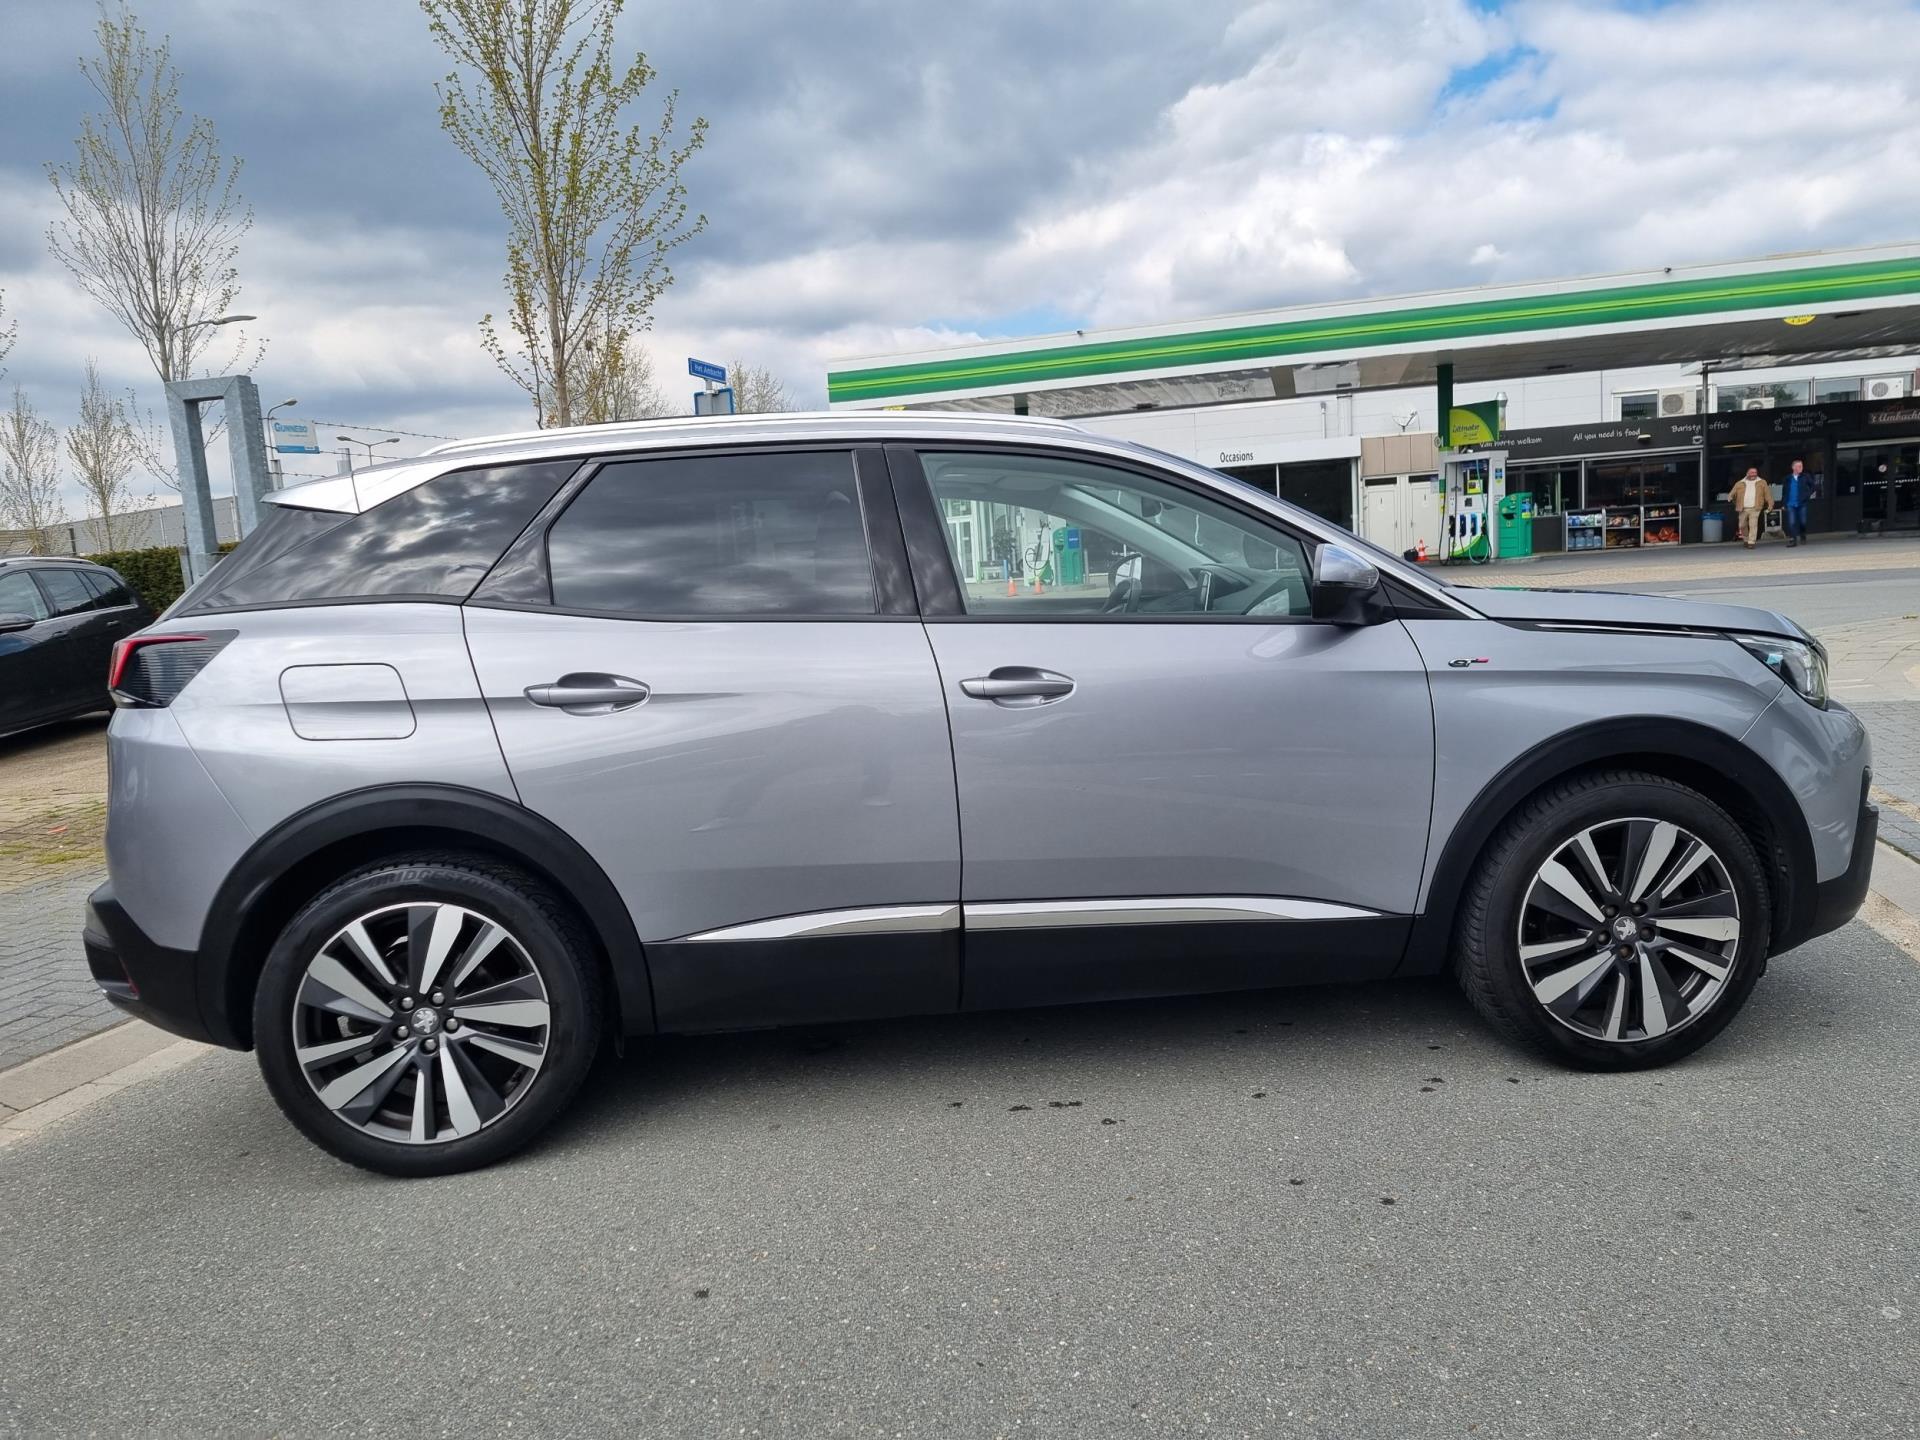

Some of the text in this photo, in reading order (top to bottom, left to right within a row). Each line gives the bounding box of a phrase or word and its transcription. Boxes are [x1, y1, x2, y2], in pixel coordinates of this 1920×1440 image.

[1706, 420, 1729, 430] offee
[1573, 432, 1583, 441] All
[1584, 433, 1597, 441] you
[1598, 430, 1615, 439] need
[1624, 428, 1641, 437] food
[1220, 450, 1254, 463] Occasions
